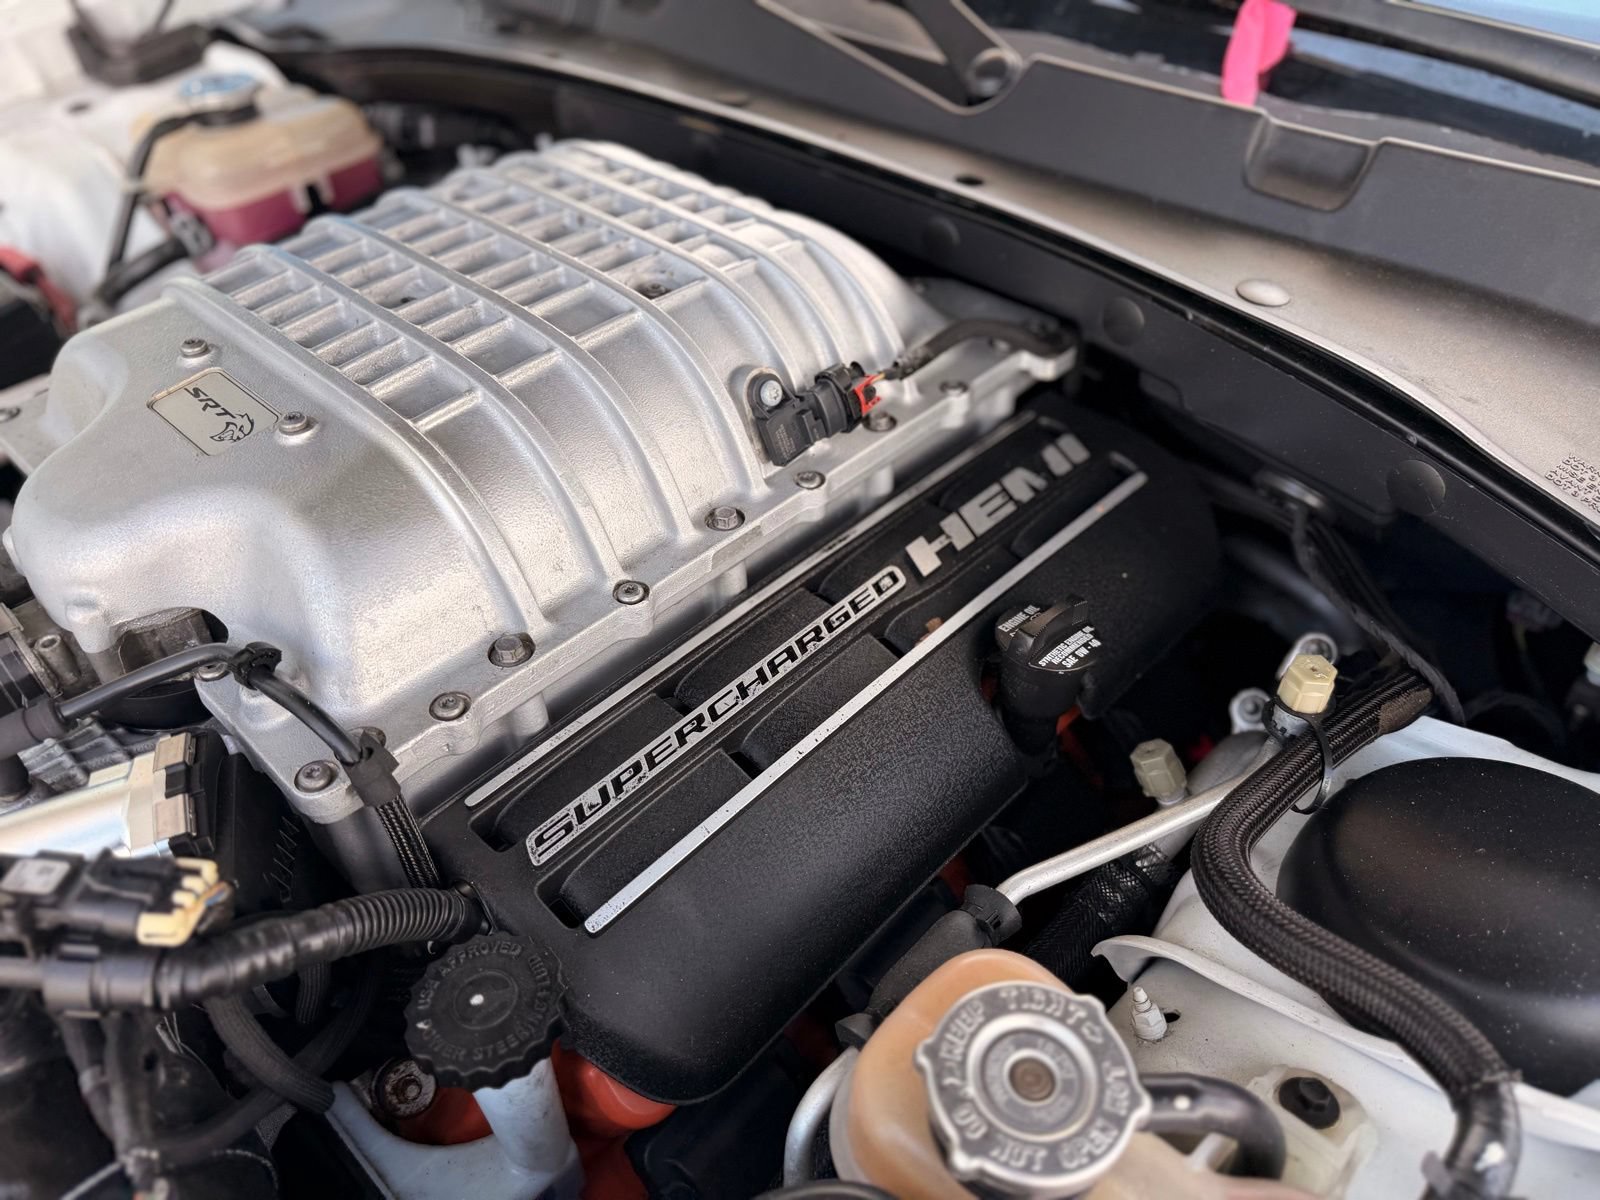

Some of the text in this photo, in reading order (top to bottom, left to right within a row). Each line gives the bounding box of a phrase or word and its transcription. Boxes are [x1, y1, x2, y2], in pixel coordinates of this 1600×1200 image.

[184, 387, 236, 418] SRT
[1545, 473, 1571, 490] DOT
[998, 605, 1040, 632] ENGINE OIL
[534, 433, 1092, 858] SUPERCHARGED HEMI
[1038, 643, 1067, 667] SYNTHETIC
[1064, 630, 1085, 646] ENGINE
[1051, 633, 1094, 665] RECOMMENDED
[1061, 654, 1079, 668] SAE
[439, 941, 522, 976] APPROVED
[473, 1001, 548, 1061] STEERING
